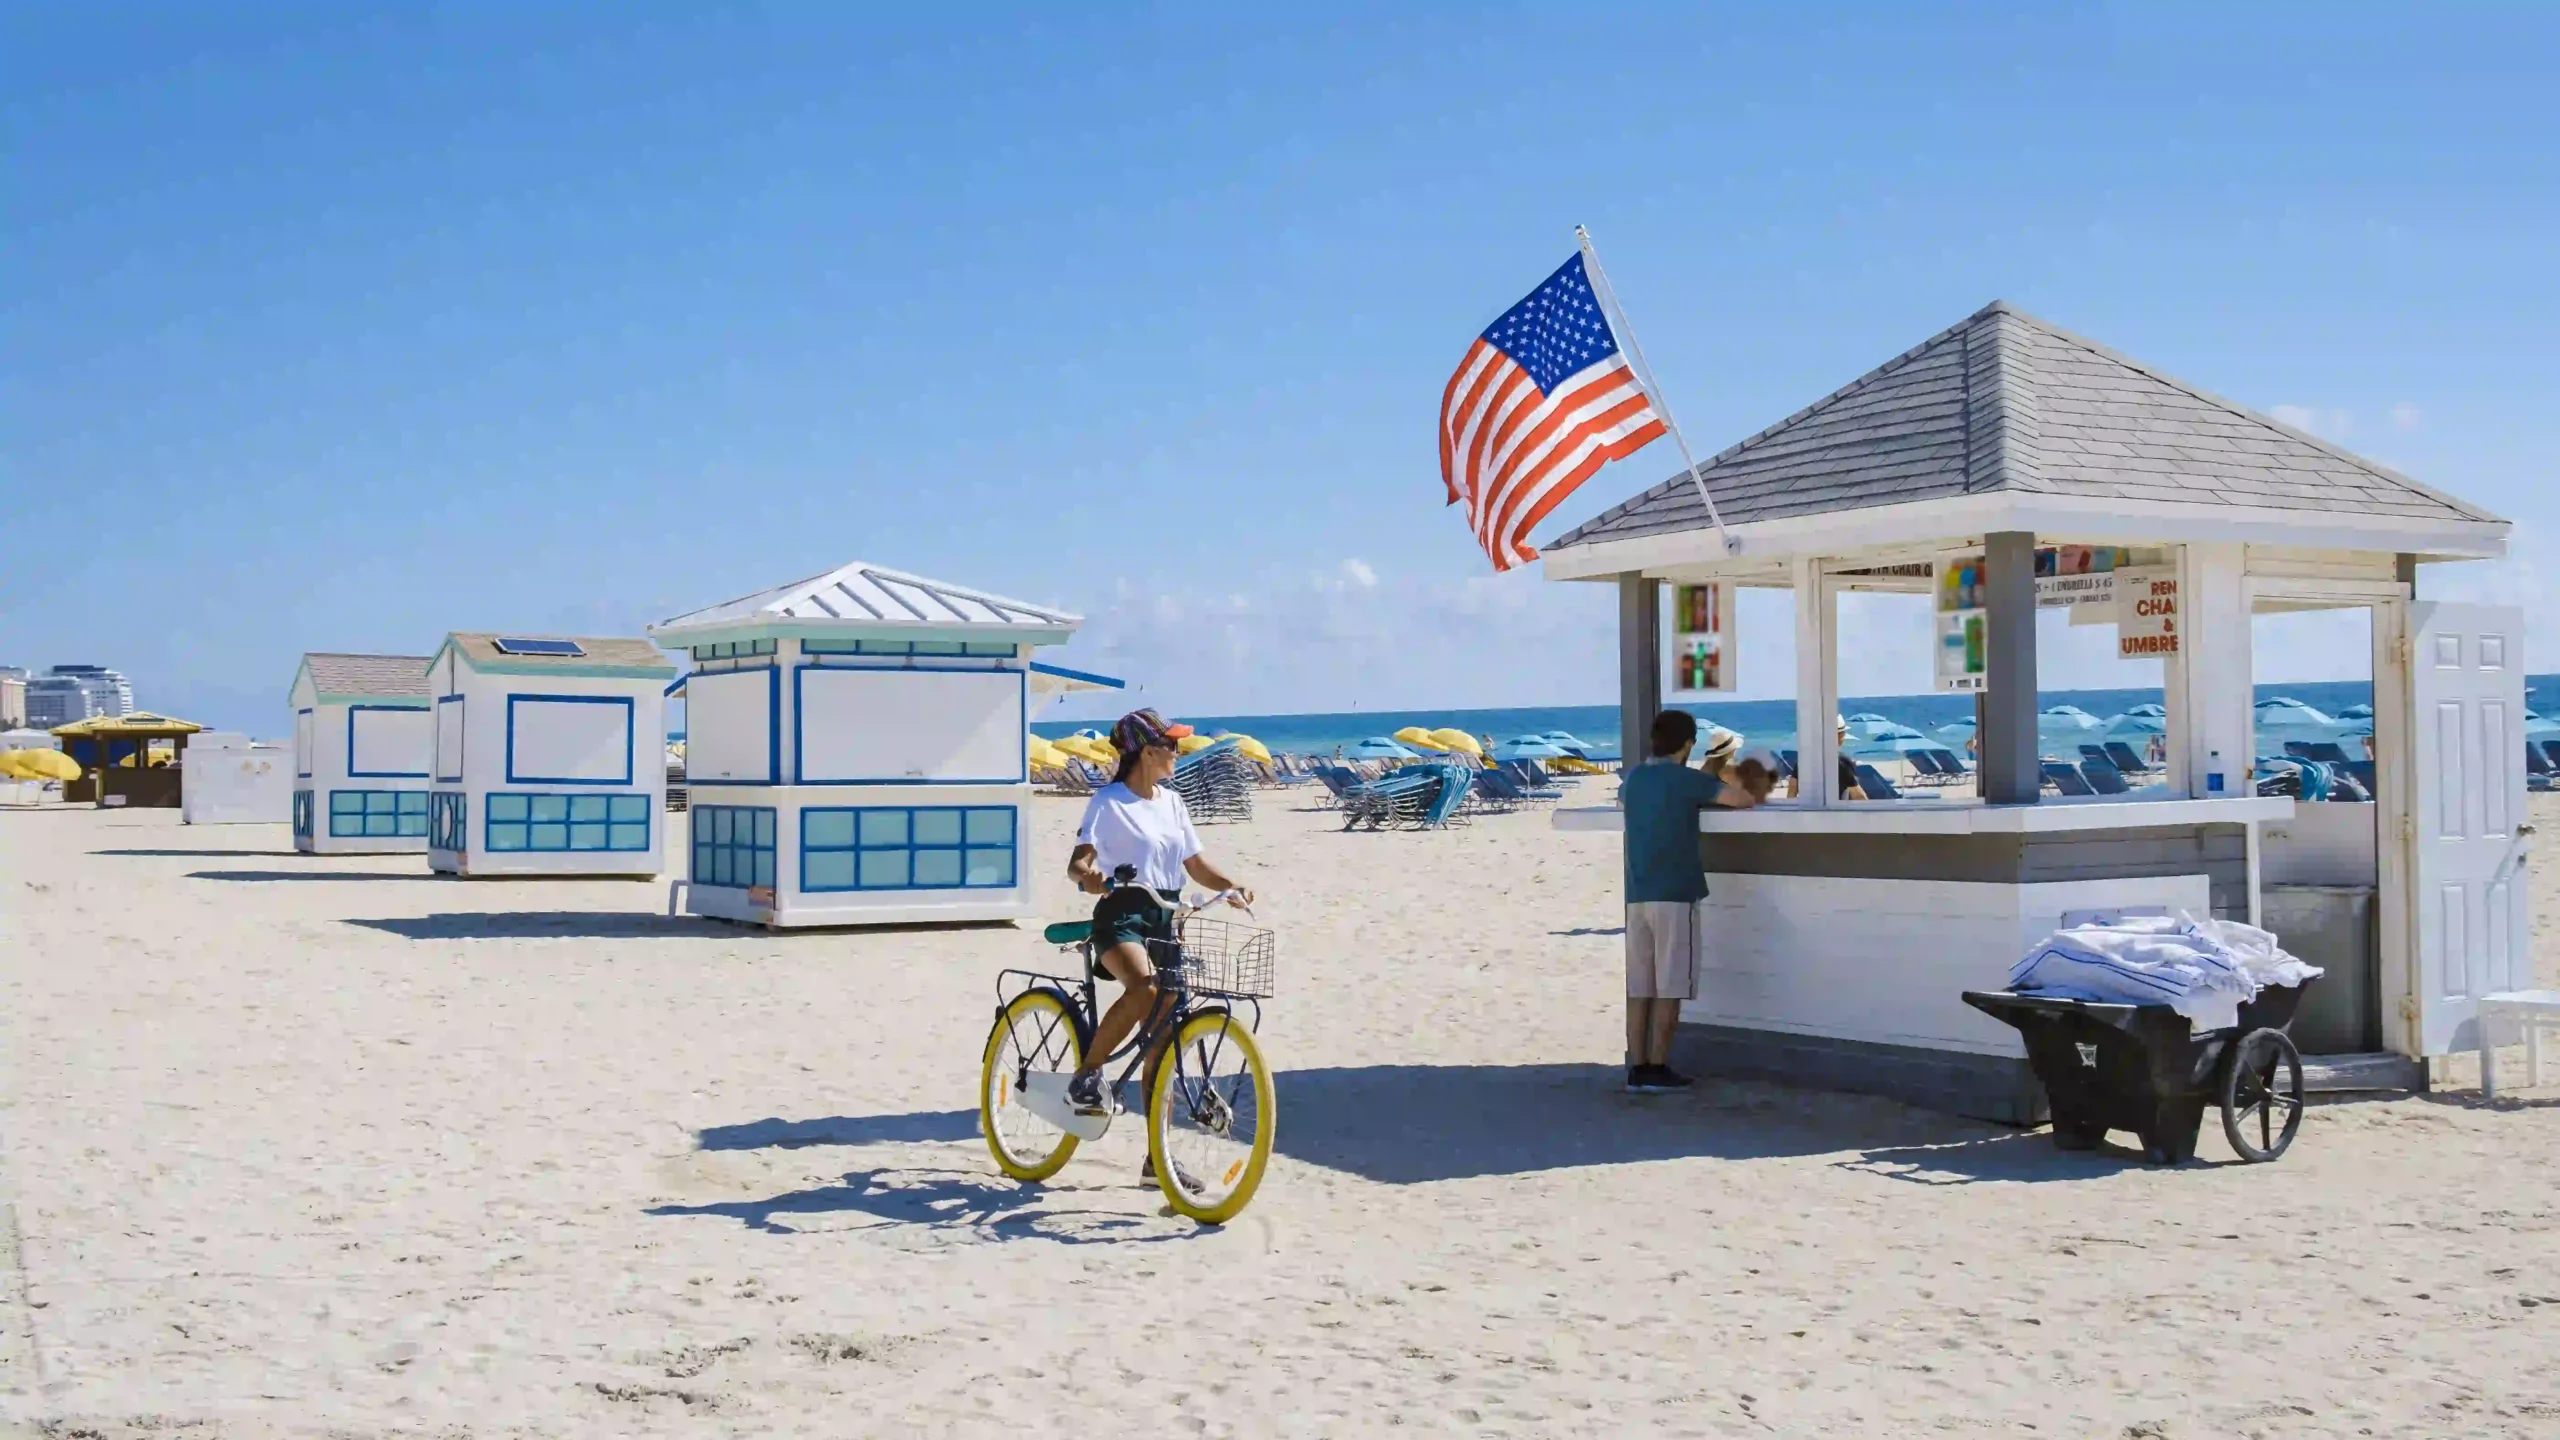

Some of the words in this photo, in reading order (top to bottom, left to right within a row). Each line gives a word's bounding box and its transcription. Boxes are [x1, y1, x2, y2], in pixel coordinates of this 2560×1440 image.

[1892, 563, 1921, 577] CHAIR
[2151, 580, 2177, 596] REN
[2164, 618, 2173, 632] &
[2122, 635, 2178, 653] UMBRE
